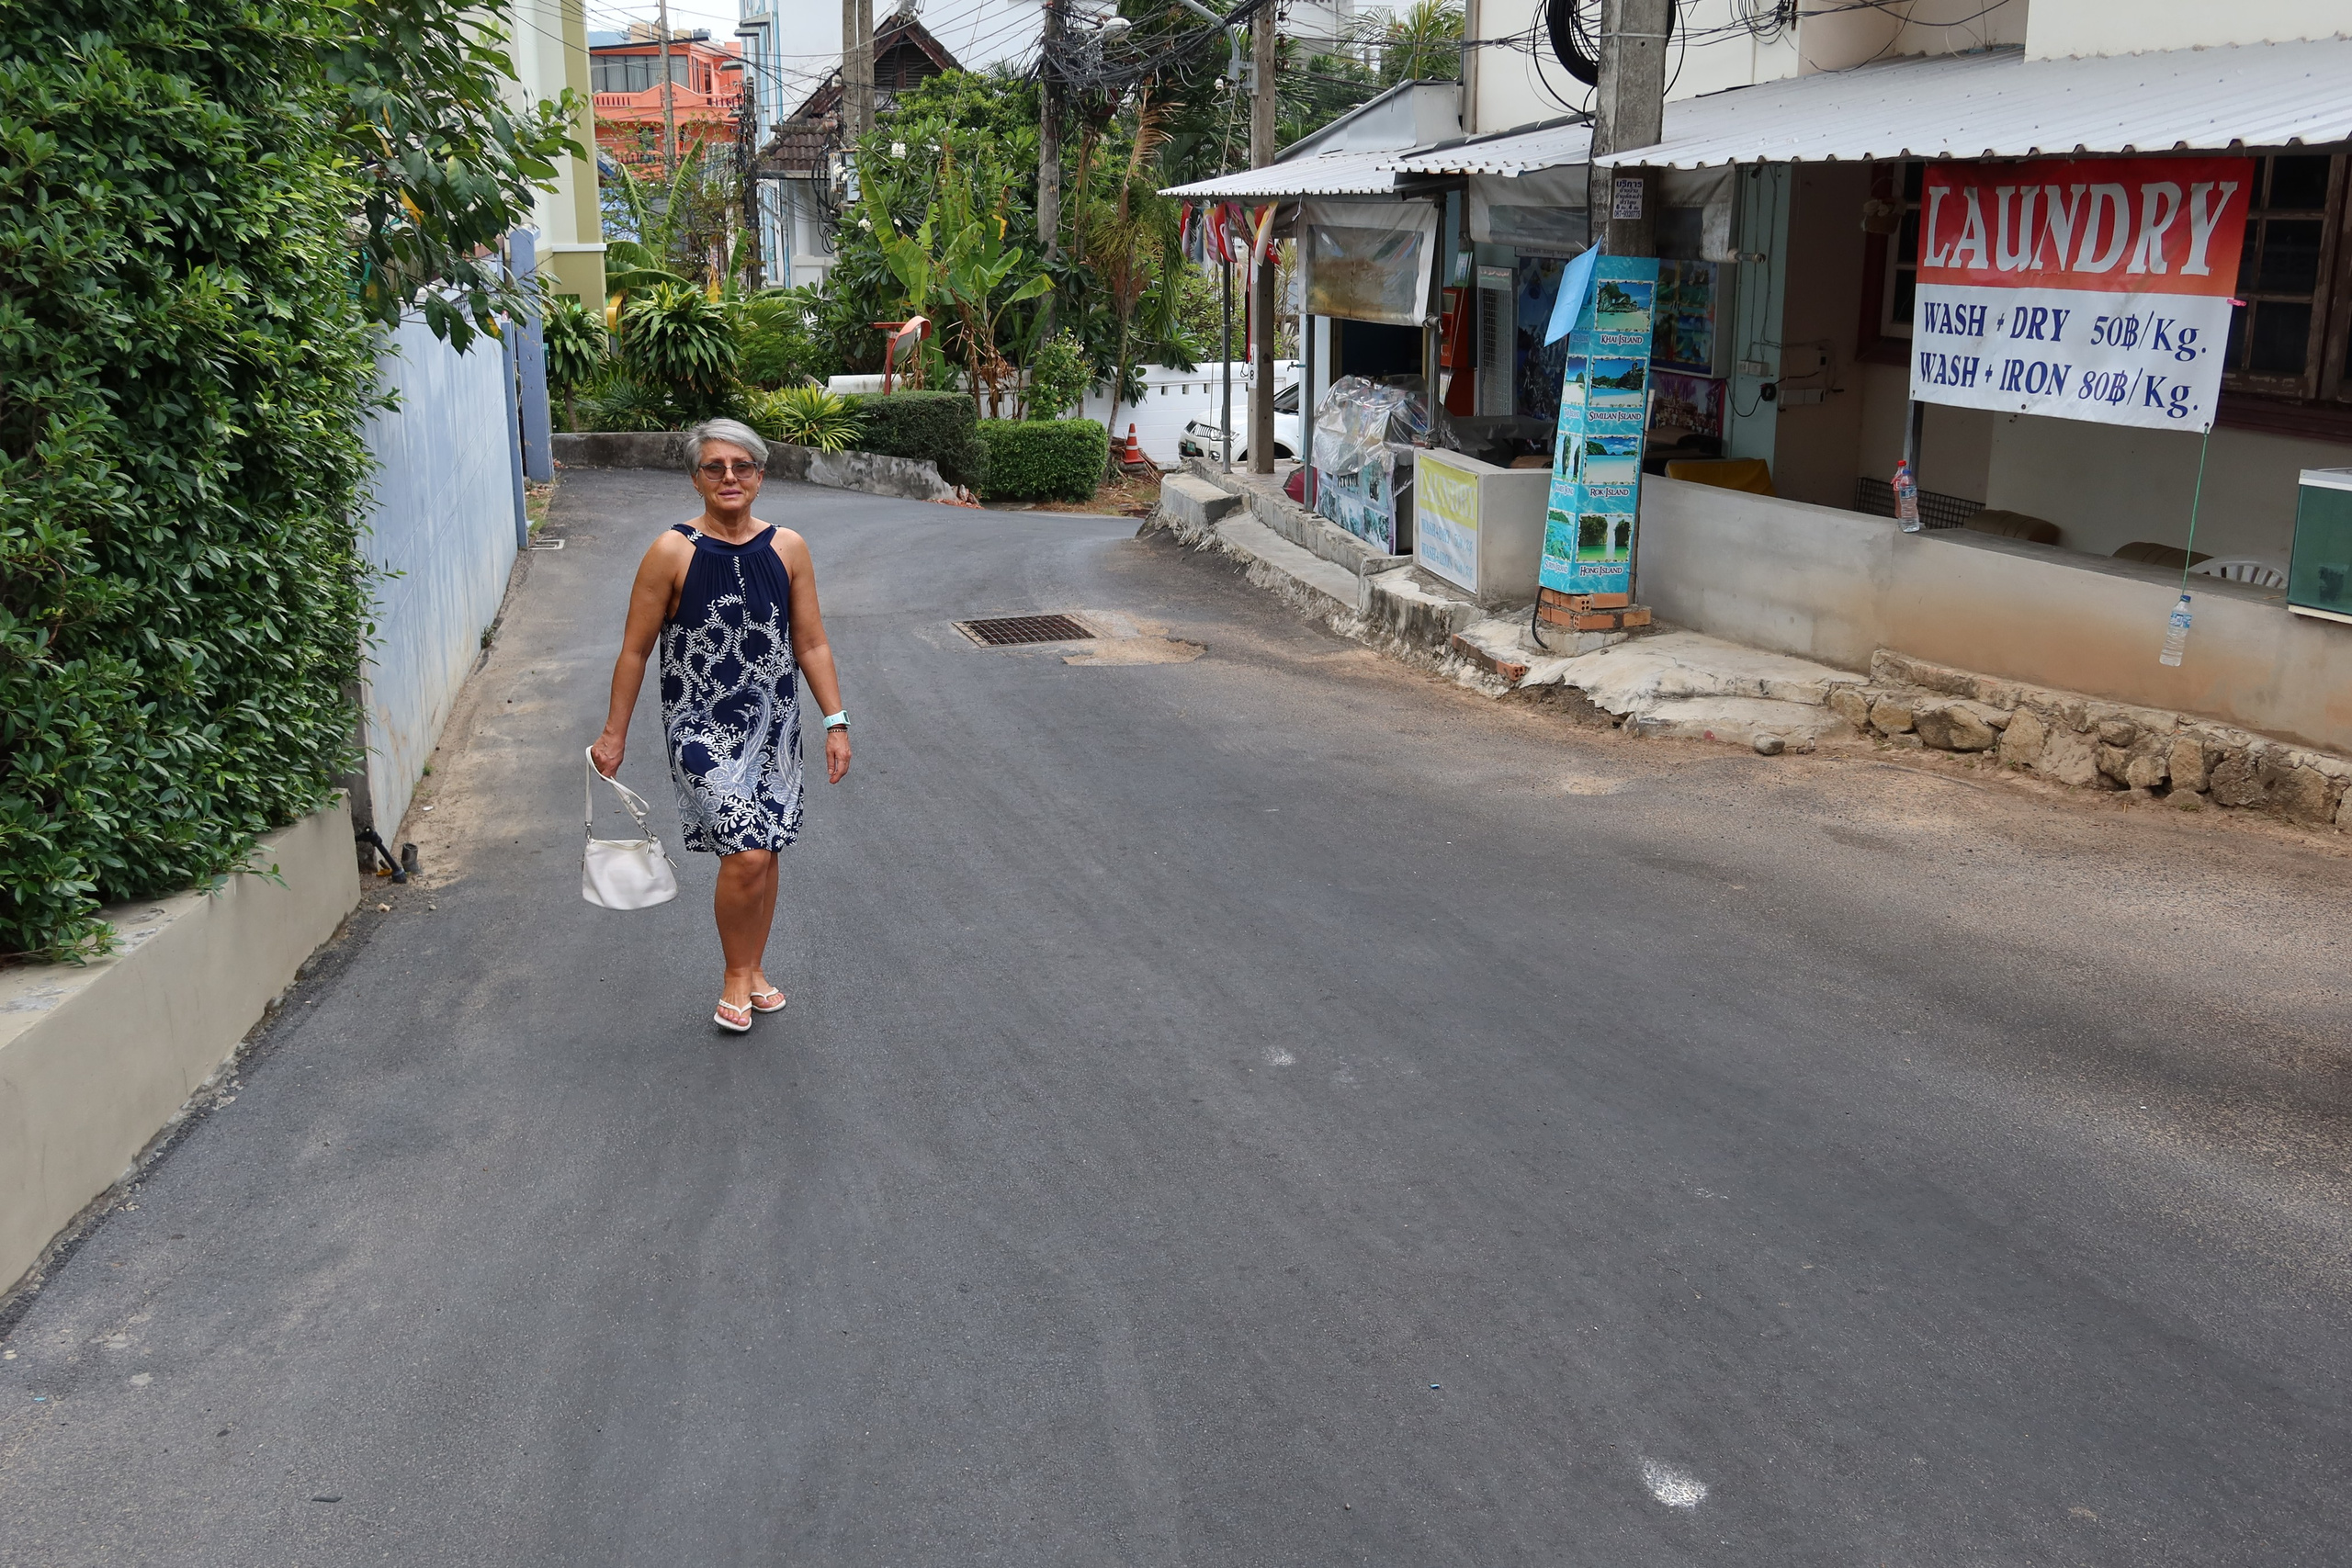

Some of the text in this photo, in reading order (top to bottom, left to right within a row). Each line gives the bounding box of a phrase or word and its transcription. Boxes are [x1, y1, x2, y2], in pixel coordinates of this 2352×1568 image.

[1924, 181, 2239, 276] LAUNDRY
[1924, 301, 1987, 337] WASH
[2009, 306, 2071, 342] DRY
[1919, 351, 1980, 388] WASH
[1998, 358, 2073, 397] IRON
